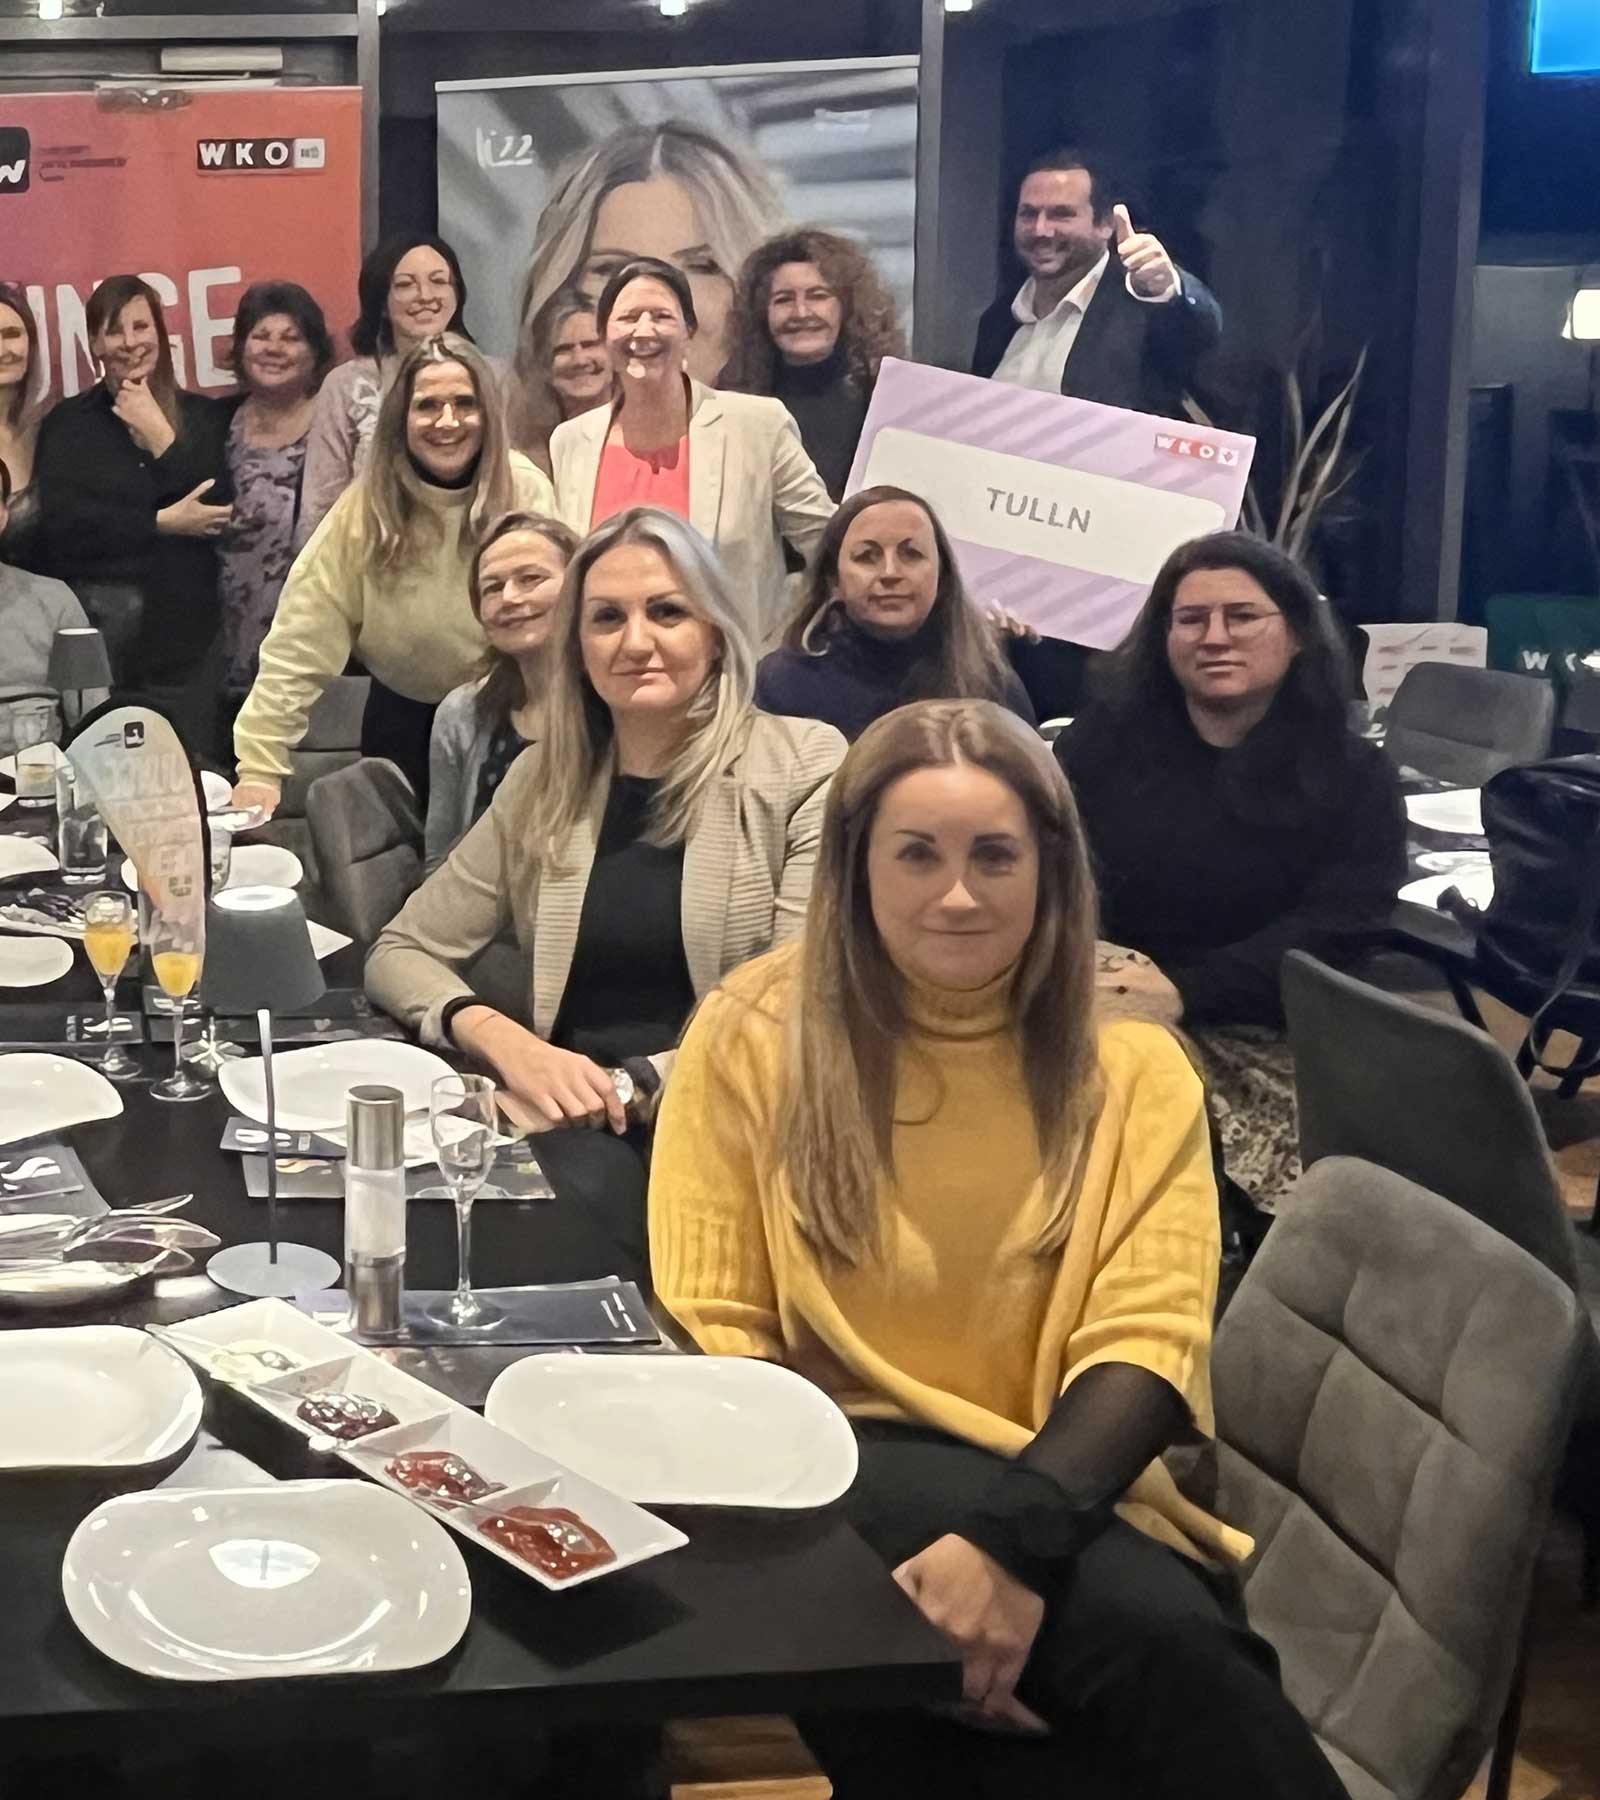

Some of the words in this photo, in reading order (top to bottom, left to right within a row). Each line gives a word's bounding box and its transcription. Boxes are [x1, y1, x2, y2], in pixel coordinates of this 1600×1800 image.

[198, 141, 289, 166] WKO
[1157, 435, 1215, 459] WKO
[986, 487, 1091, 533] TULLN
